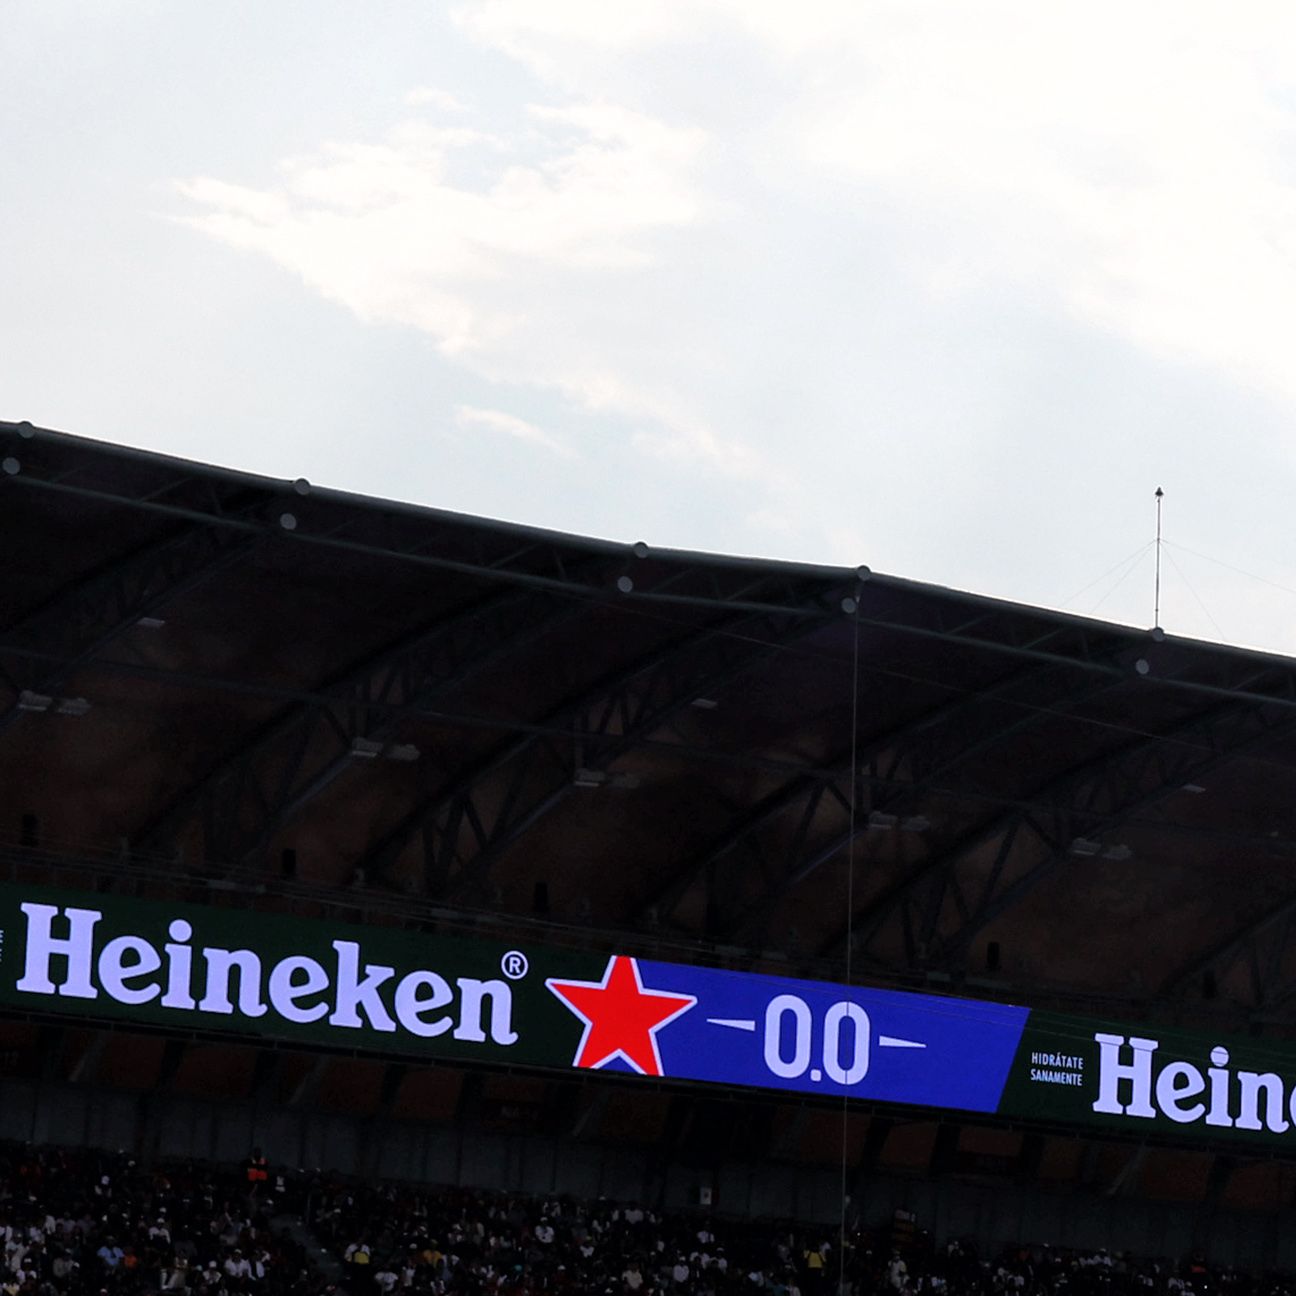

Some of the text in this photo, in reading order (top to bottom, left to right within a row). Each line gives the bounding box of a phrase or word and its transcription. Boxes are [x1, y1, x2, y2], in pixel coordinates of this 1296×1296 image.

[764, 994, 870, 1085] 0.0
[1032, 1052, 1083, 1071] HIDRÁTATE
[1031, 1068, 1083, 1086] SANAMENTE
